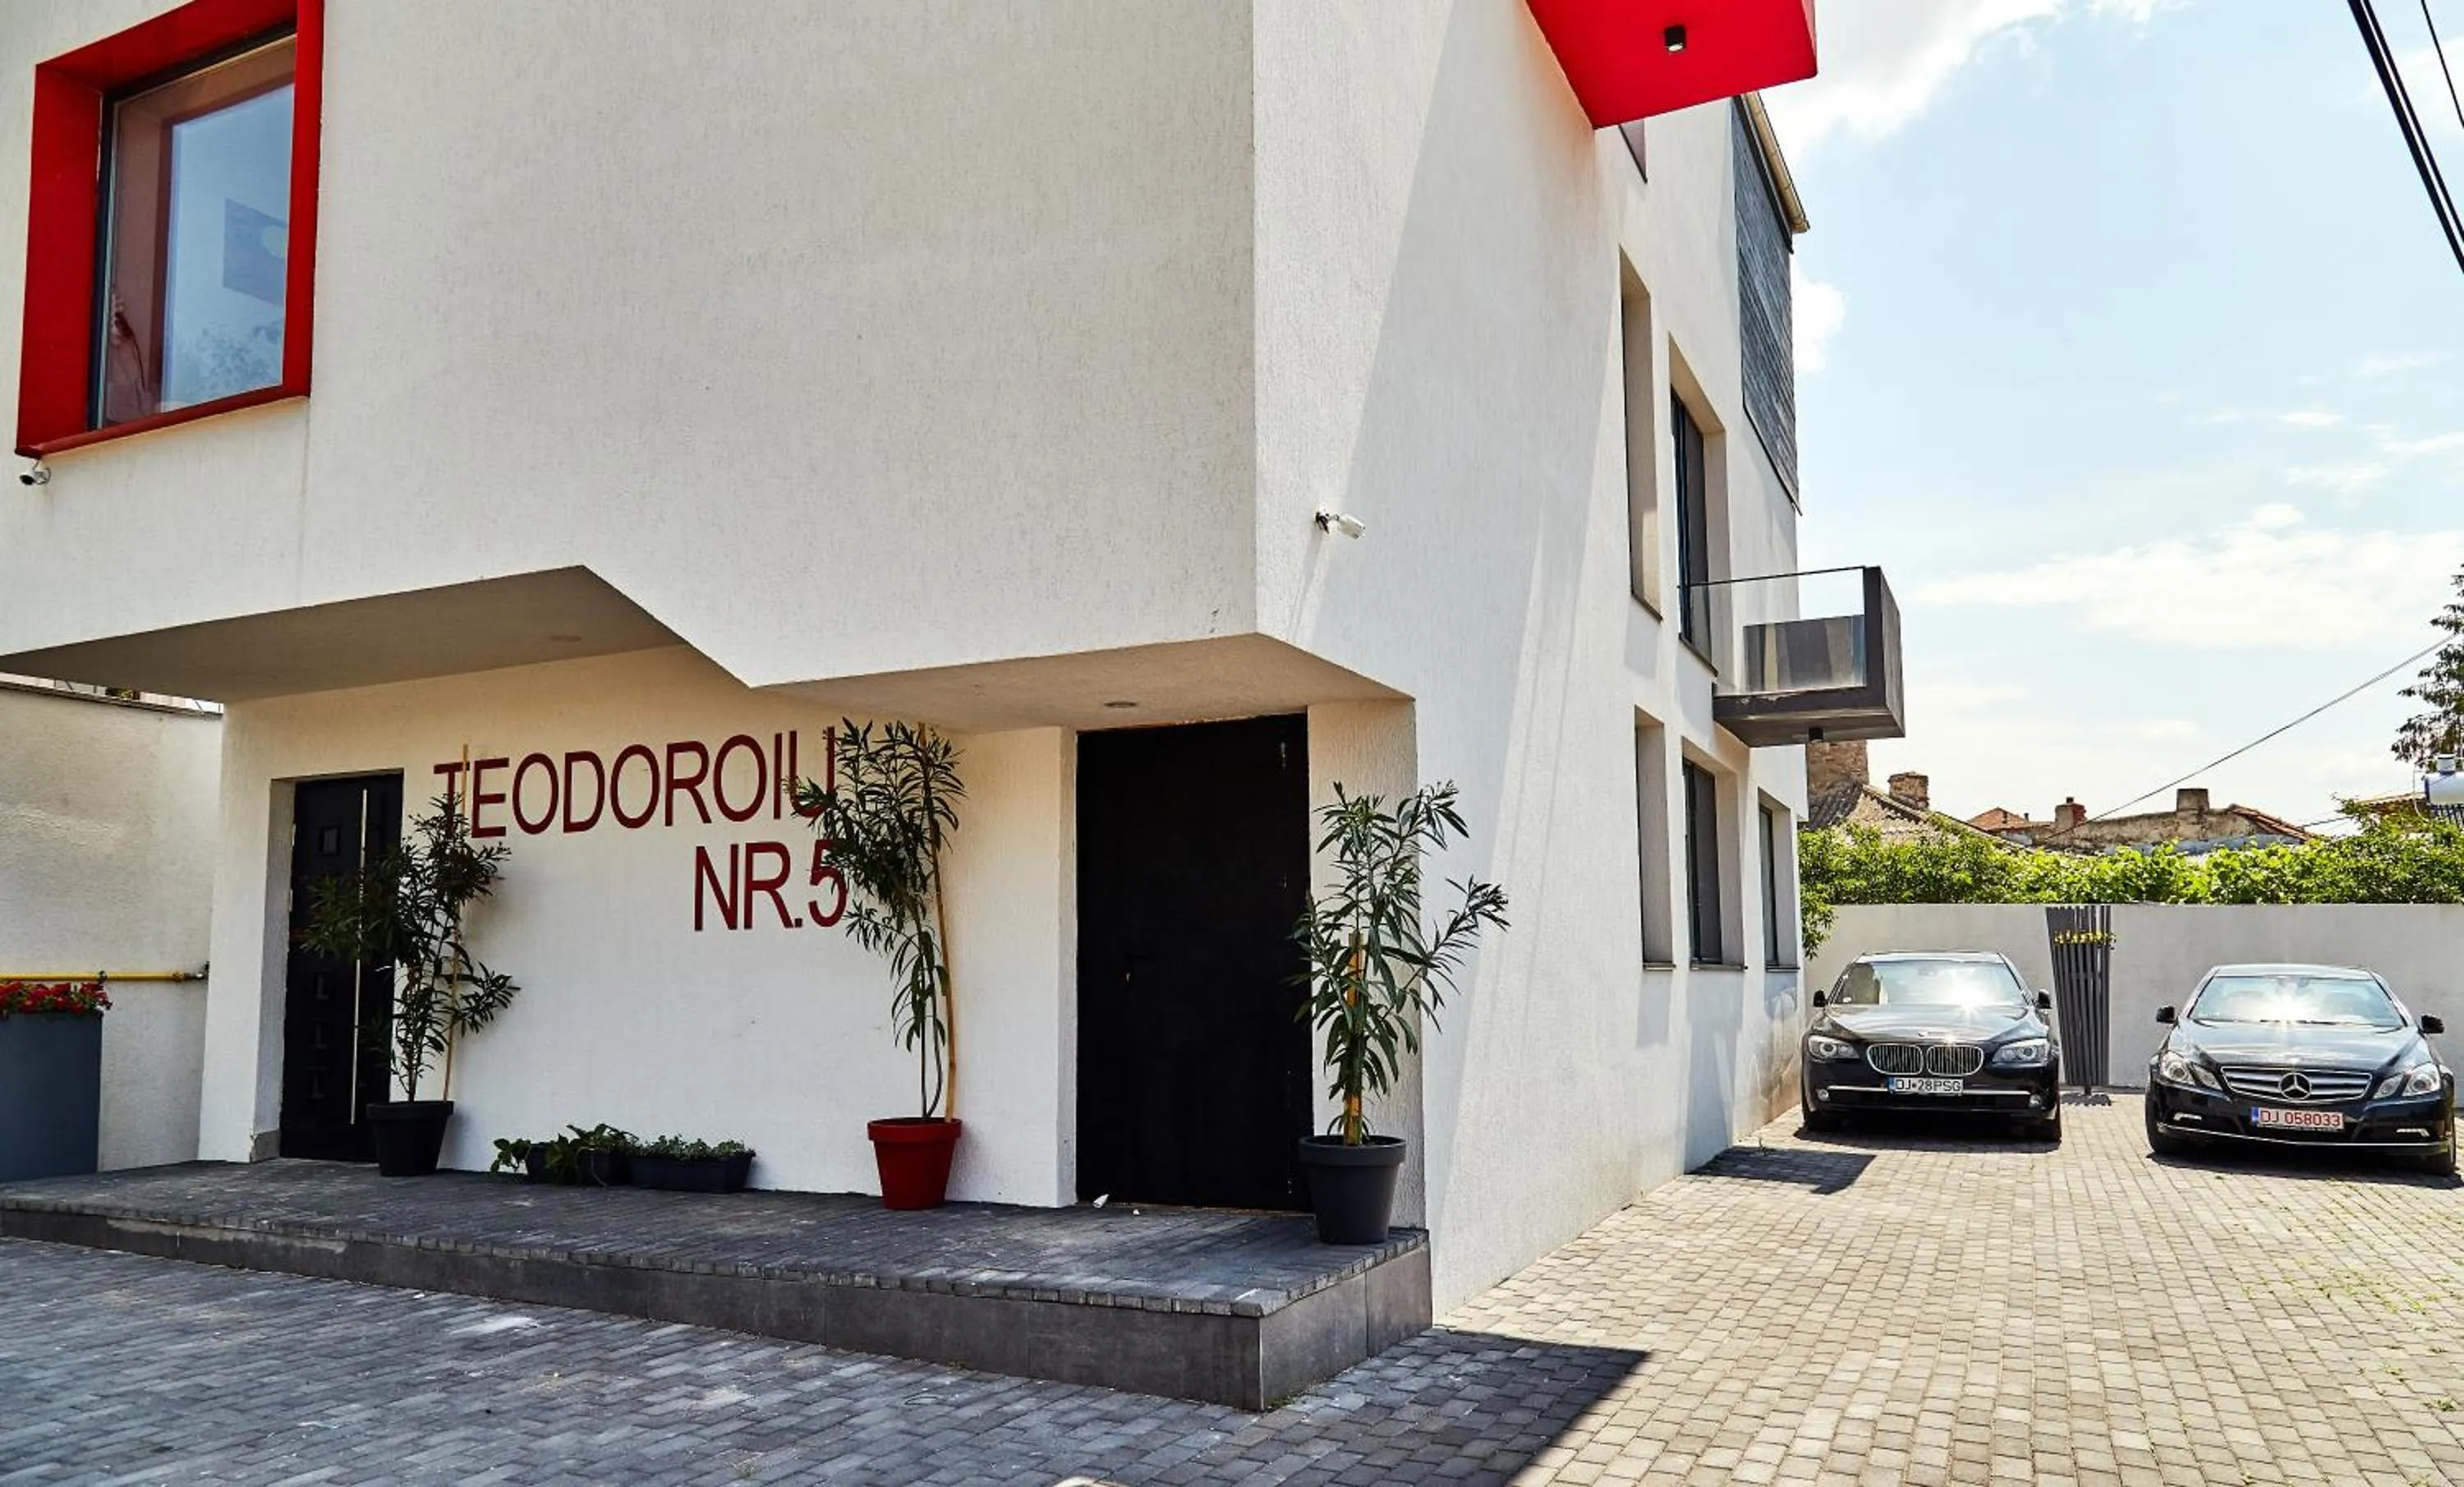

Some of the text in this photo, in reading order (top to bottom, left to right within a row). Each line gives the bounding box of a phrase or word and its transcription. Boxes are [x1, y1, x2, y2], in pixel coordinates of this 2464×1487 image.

[433, 726, 835, 839] TEODOROIU
[1895, 1079, 1912, 1091] DJ
[2259, 1110, 2341, 1126] DJ 058033
